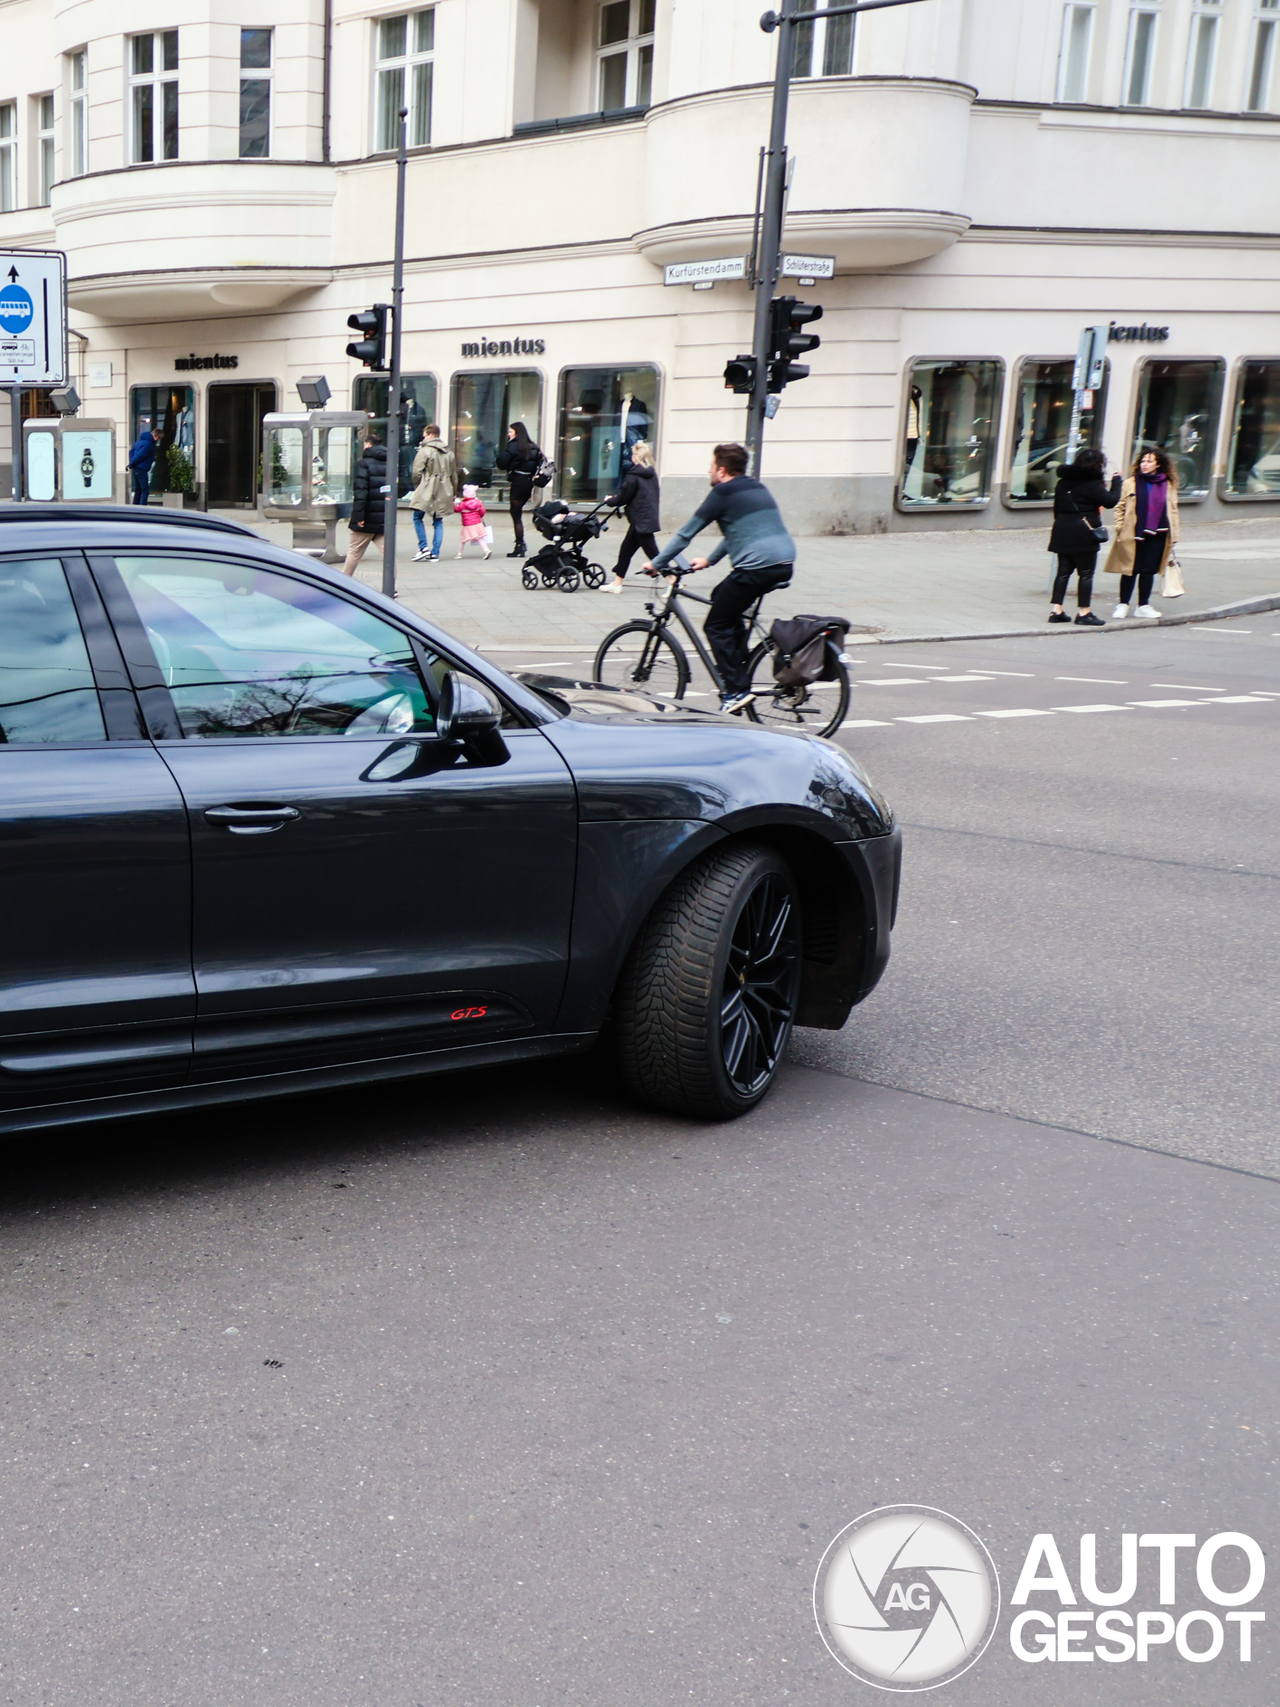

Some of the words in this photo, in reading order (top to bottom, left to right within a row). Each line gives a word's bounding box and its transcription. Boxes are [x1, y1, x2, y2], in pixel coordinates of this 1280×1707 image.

[668, 262, 743, 279] Kurfürstendamm
[786, 258, 831, 275] Schlüterstraße
[1108, 320, 1170, 342] ientus
[460, 335, 546, 357] mientus
[174, 353, 239, 371] mientus
[450, 1005, 488, 1020] GTS
